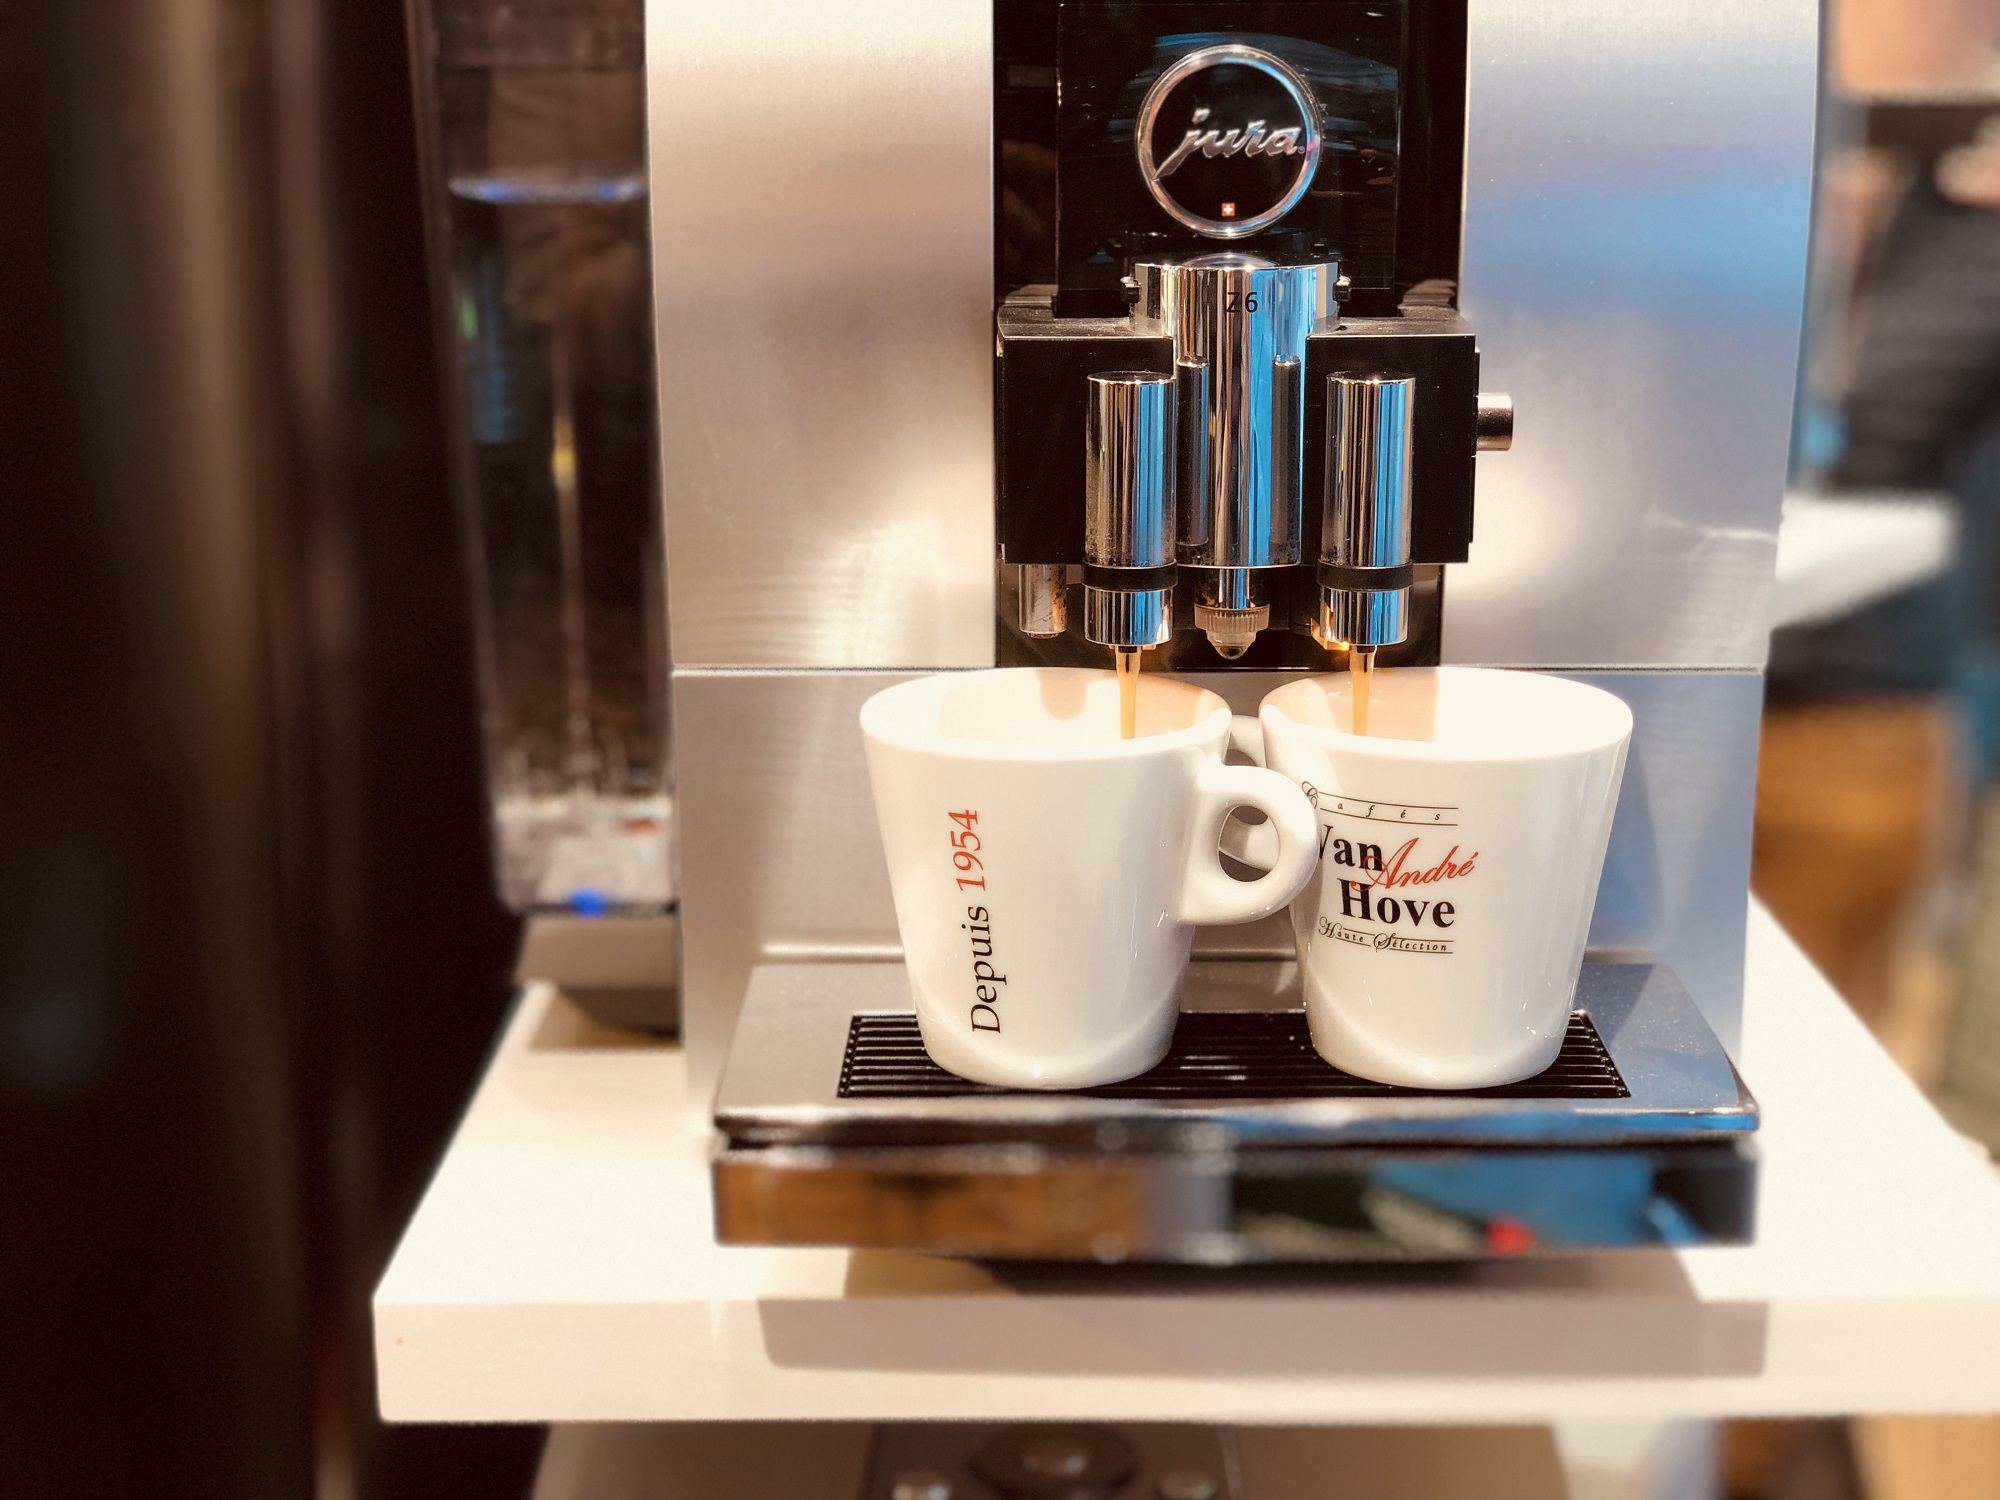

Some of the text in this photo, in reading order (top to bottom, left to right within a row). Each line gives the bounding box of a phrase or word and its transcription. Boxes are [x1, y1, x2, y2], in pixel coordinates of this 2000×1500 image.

[1152, 108, 1301, 182] jura
[1226, 291, 1259, 313] Z6
[1350, 837, 1479, 892] André
[947, 809, 1008, 1034] Depuis 1954
[1336, 877, 1456, 929] Hove
[1318, 916, 1447, 953] Haute Sélection
